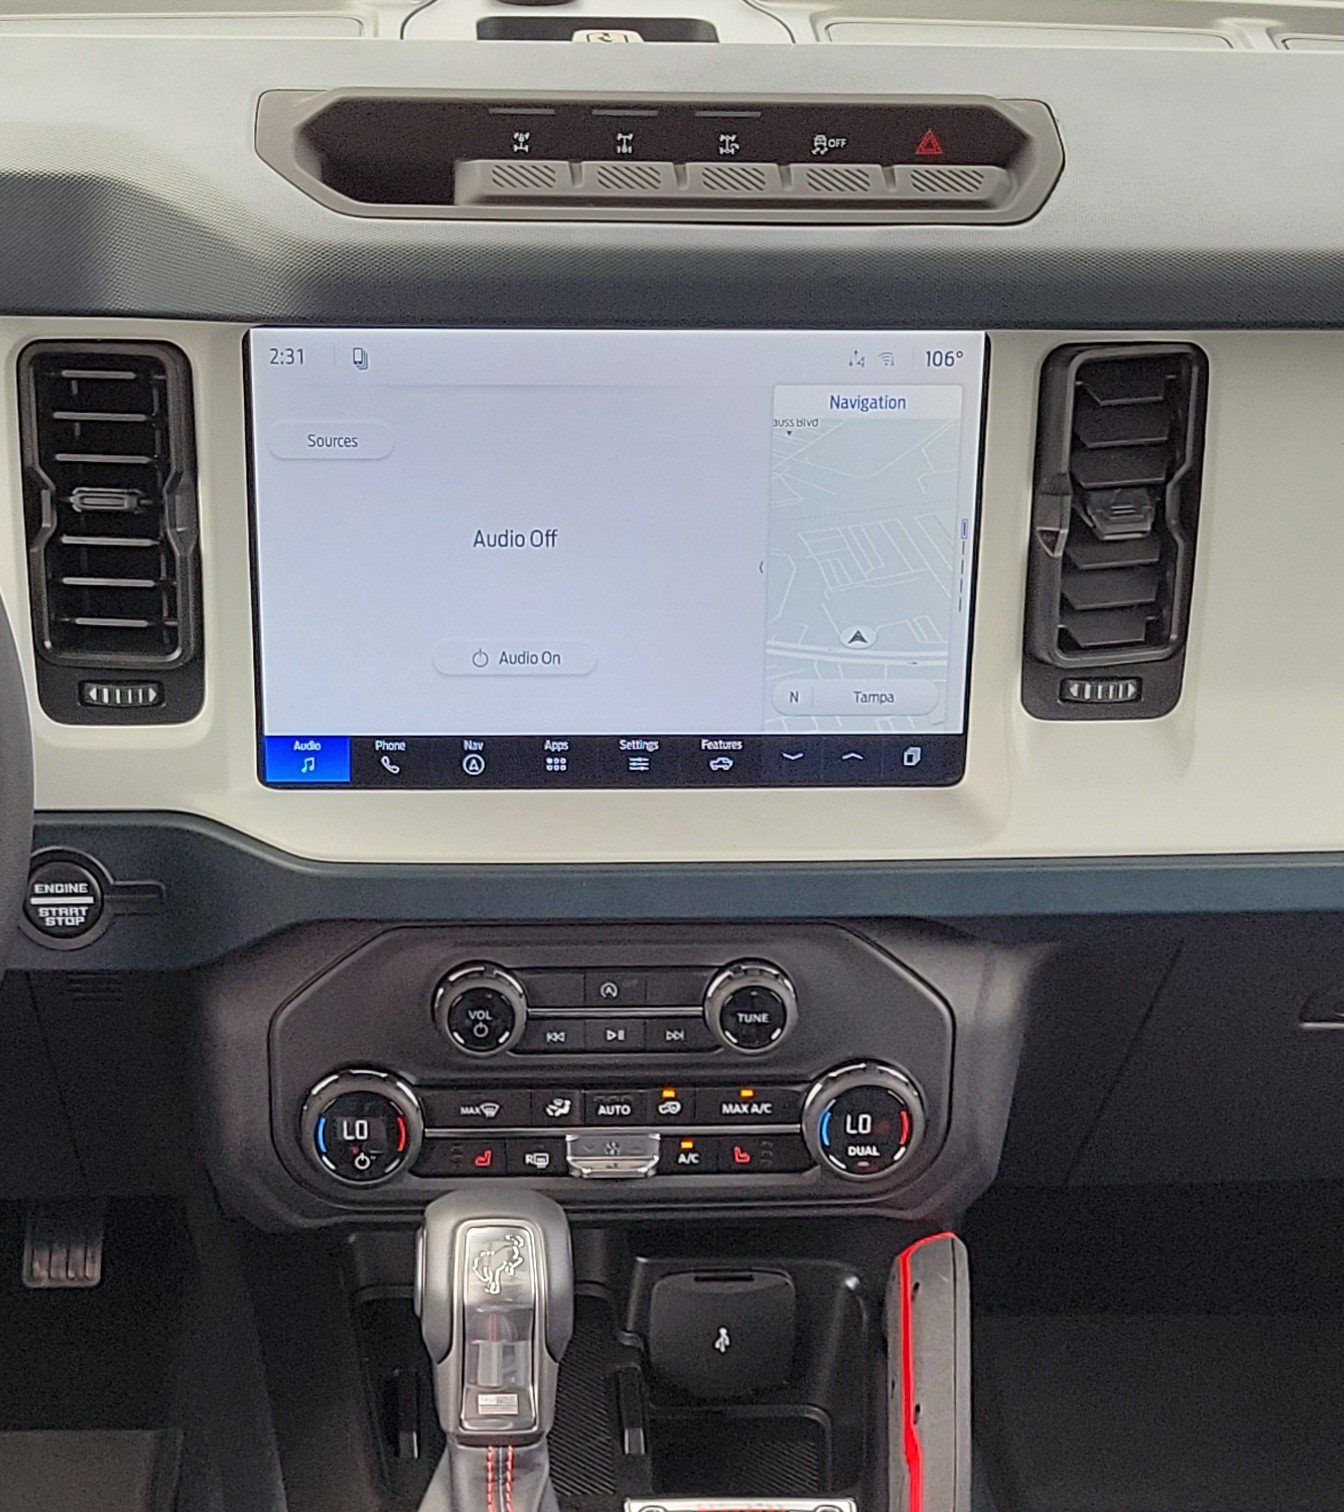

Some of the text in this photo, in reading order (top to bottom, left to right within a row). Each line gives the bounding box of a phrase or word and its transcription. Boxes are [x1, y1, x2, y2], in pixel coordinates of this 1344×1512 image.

[828, 137, 847, 149] OFF
[269, 348, 304, 365] 2:31
[926, 350, 963, 367] 106°
[829, 395, 906, 412] Navigation
[307, 434, 358, 447] Sources
[473, 529, 558, 548] Audio Off
[499, 651, 561, 665] Audio On
[789, 691, 799, 703] N
[853, 691, 895, 705] Tampa
[293, 740, 322, 751] Audio
[375, 740, 407, 751] Phone
[463, 740, 484, 751] Nav
[544, 740, 569, 752] Apps
[619, 740, 660, 752] Settings
[701, 739, 743, 751] Features
[34, 883, 89, 894] ENGINE
[38, 907, 89, 917] START
[45, 916, 86, 927] STOP
[469, 1010, 492, 1021] VOL
[737, 1013, 770, 1023] TUNE
[460, 1106, 480, 1115] MAX
[598, 1105, 631, 1116] AUTO
[722, 1104, 772, 1115] MAX A/C
[342, 1120, 368, 1140] LO
[846, 1114, 872, 1135] LO
[847, 1146, 880, 1157] DUAL
[678, 1153, 700, 1164] A/C
